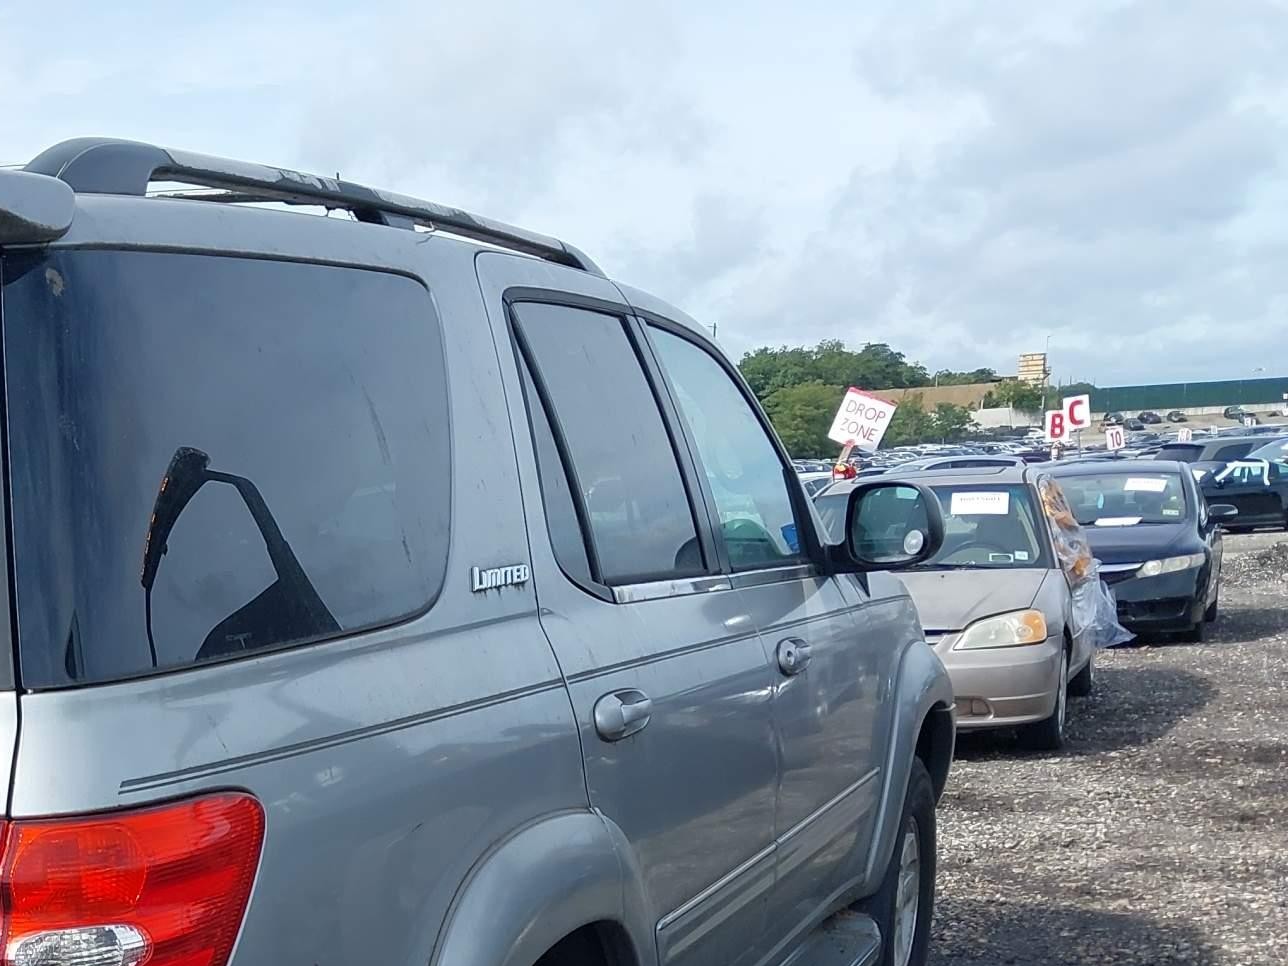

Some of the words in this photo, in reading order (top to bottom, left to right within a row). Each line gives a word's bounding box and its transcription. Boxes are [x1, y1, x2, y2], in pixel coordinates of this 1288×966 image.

[845, 399, 886, 424] DROP
[1069, 399, 1085, 426] C
[839, 417, 880, 442] ZONE
[1050, 413, 1065, 439] B
[1109, 431, 1122, 448] 10
